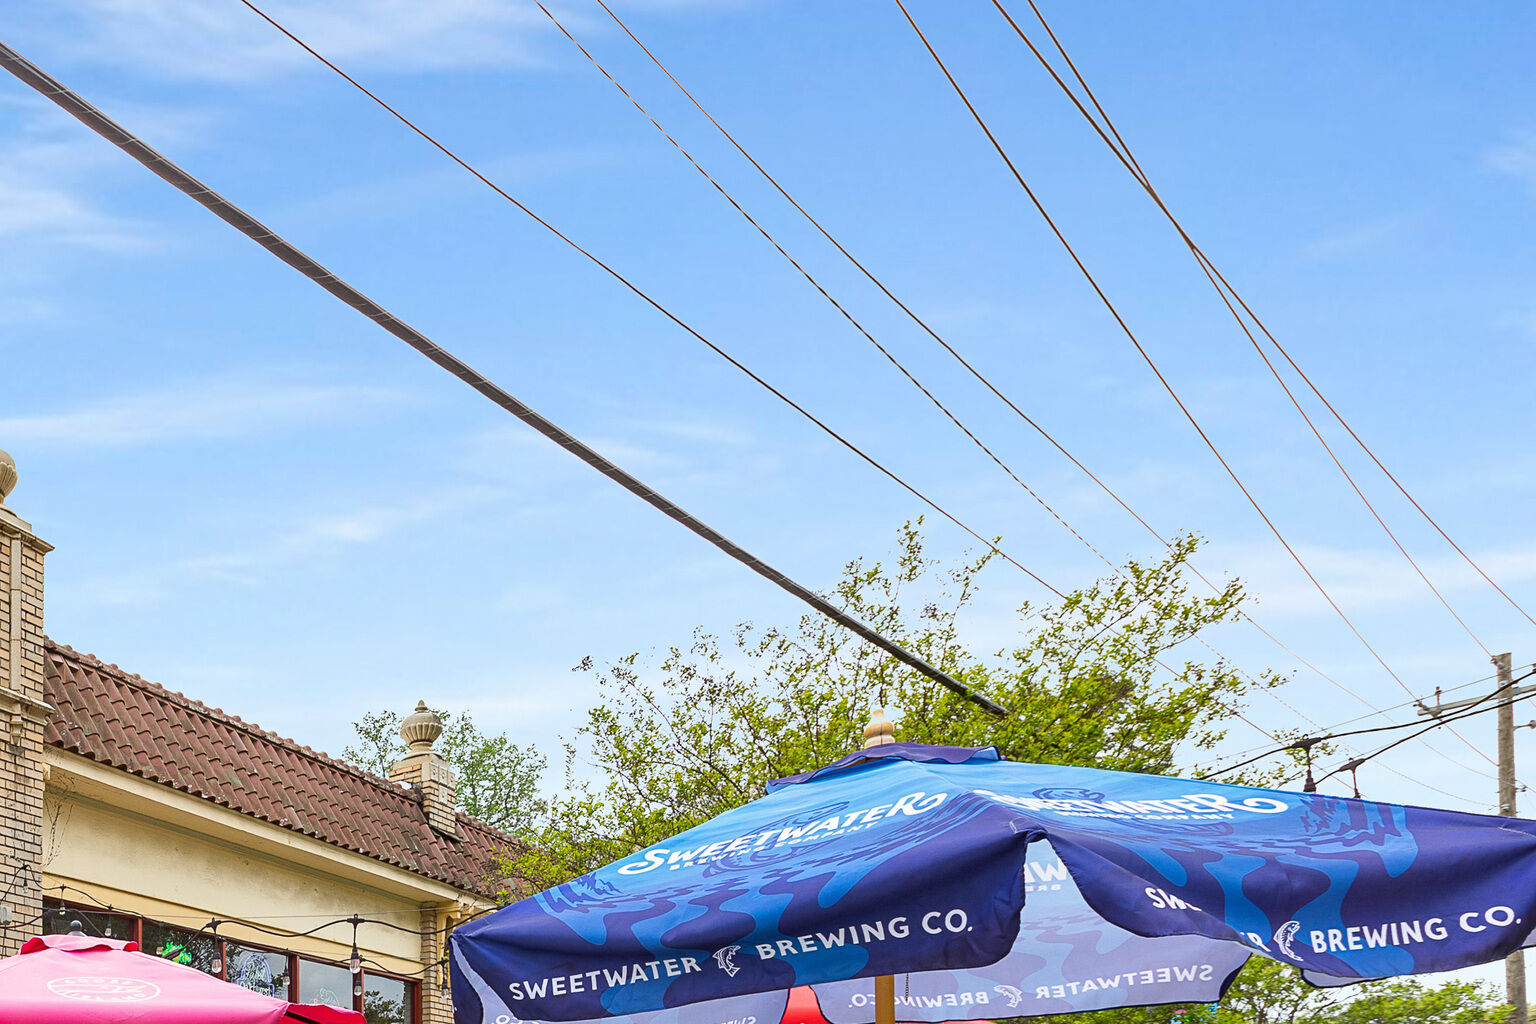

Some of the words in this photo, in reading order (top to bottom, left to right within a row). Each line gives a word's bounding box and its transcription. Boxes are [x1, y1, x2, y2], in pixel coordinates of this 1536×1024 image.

[617, 791, 948, 875] SWEETWATER
[669, 846, 764, 871] BREWING
[774, 821, 879, 848] COMPANY
[509, 956, 702, 1002] SWEETWATER
[755, 916, 911, 962] BREWING
[921, 909, 974, 933] CO.
[1311, 917, 1449, 954] BREWING
[1459, 905, 1522, 934] CO.
